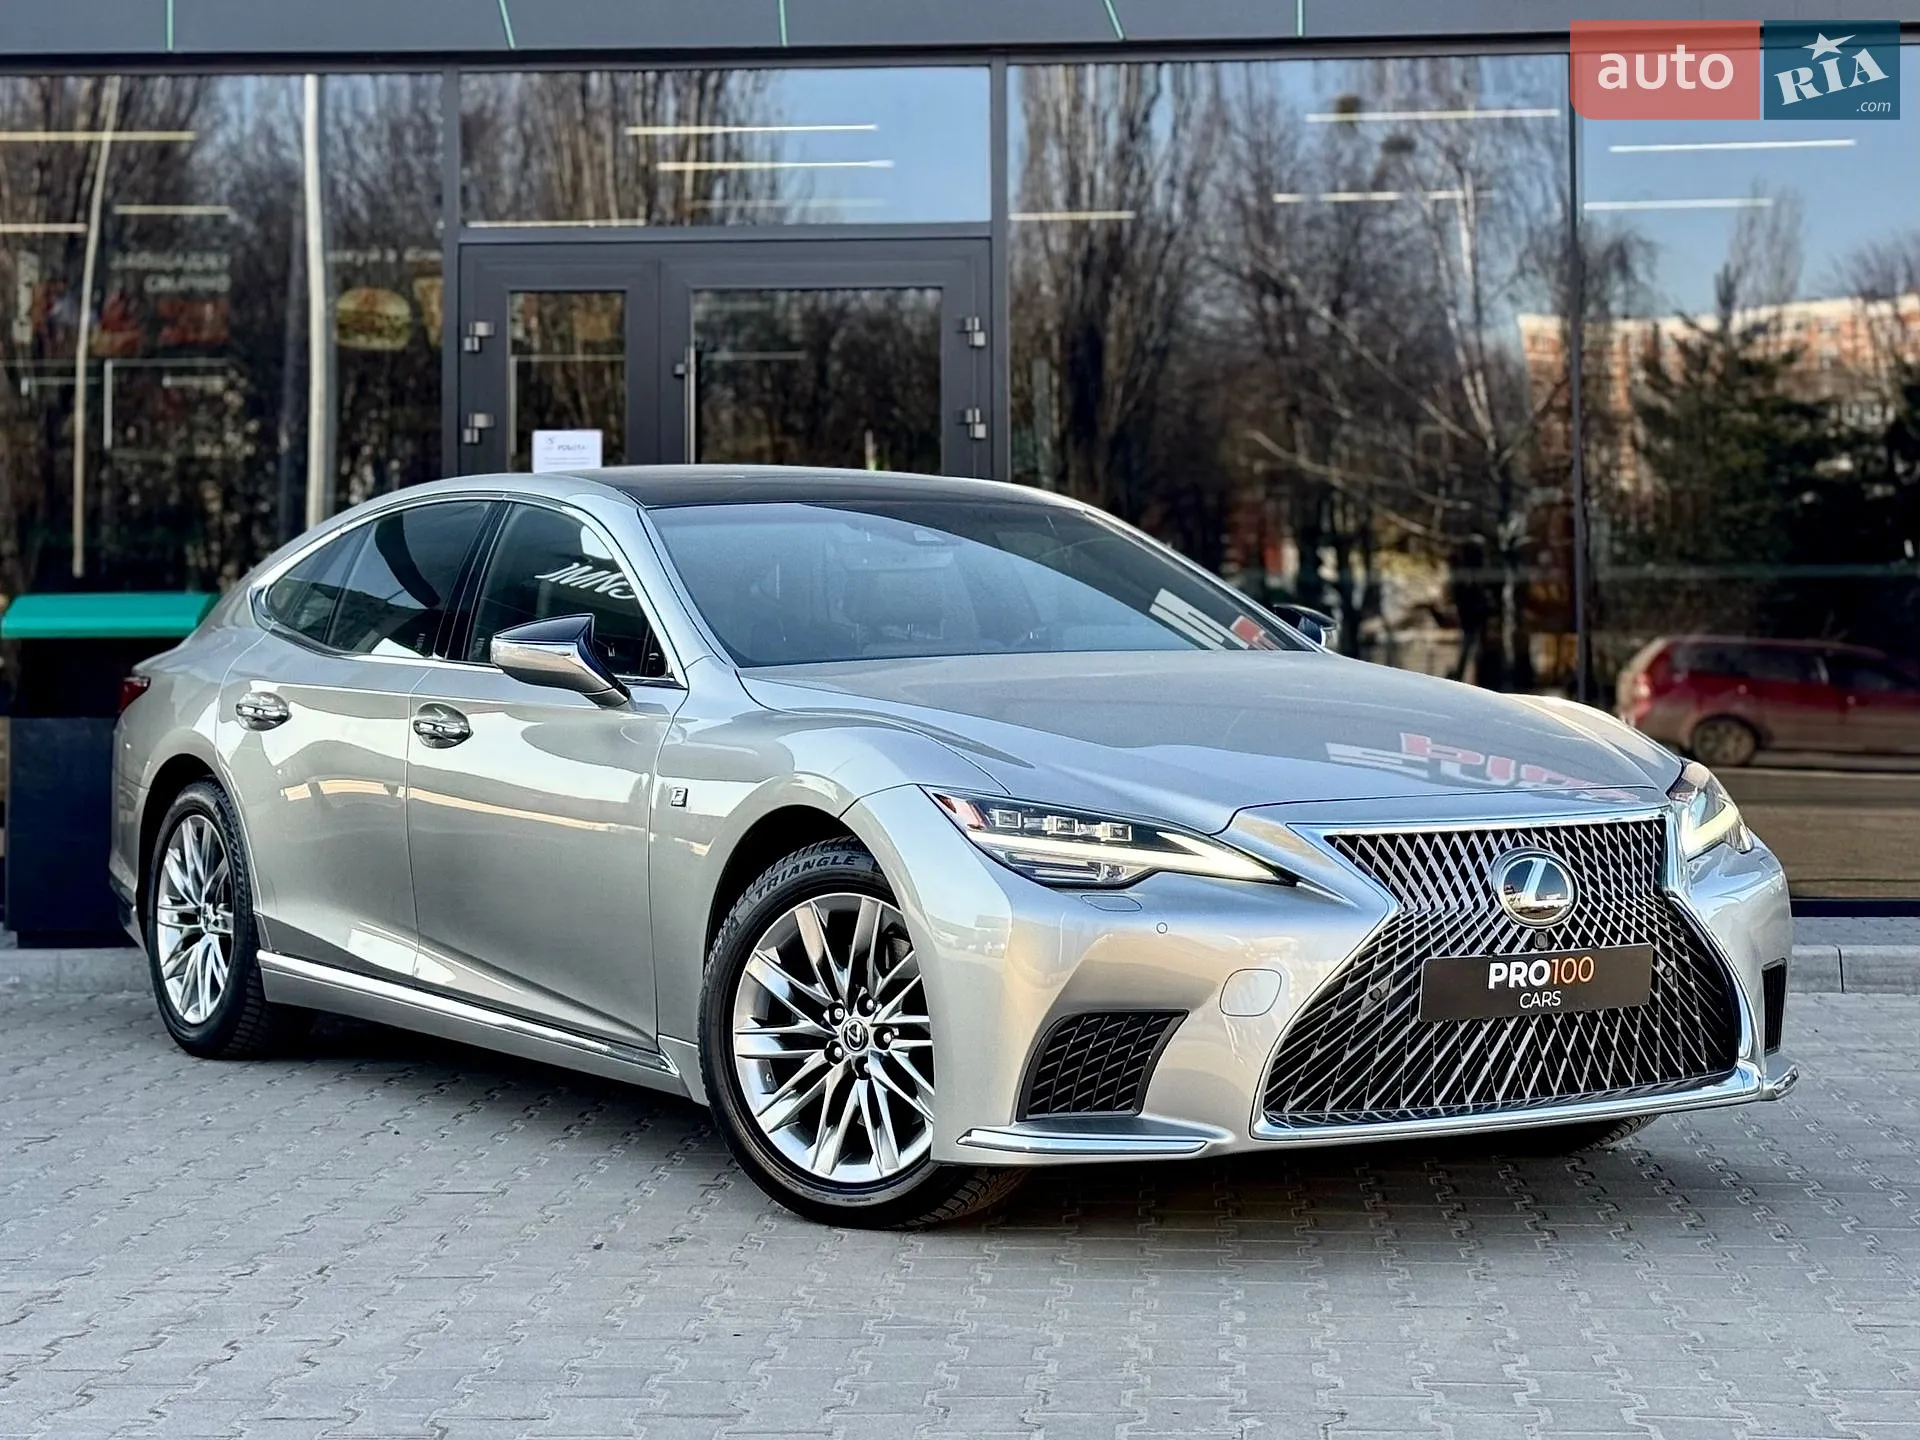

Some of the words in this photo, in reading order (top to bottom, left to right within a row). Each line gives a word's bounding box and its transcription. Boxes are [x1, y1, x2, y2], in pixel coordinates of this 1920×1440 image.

[755, 854, 860, 900] TRIANGLE
[1487, 955, 1595, 990] PRO100
[1519, 990, 1562, 1009] CARS
